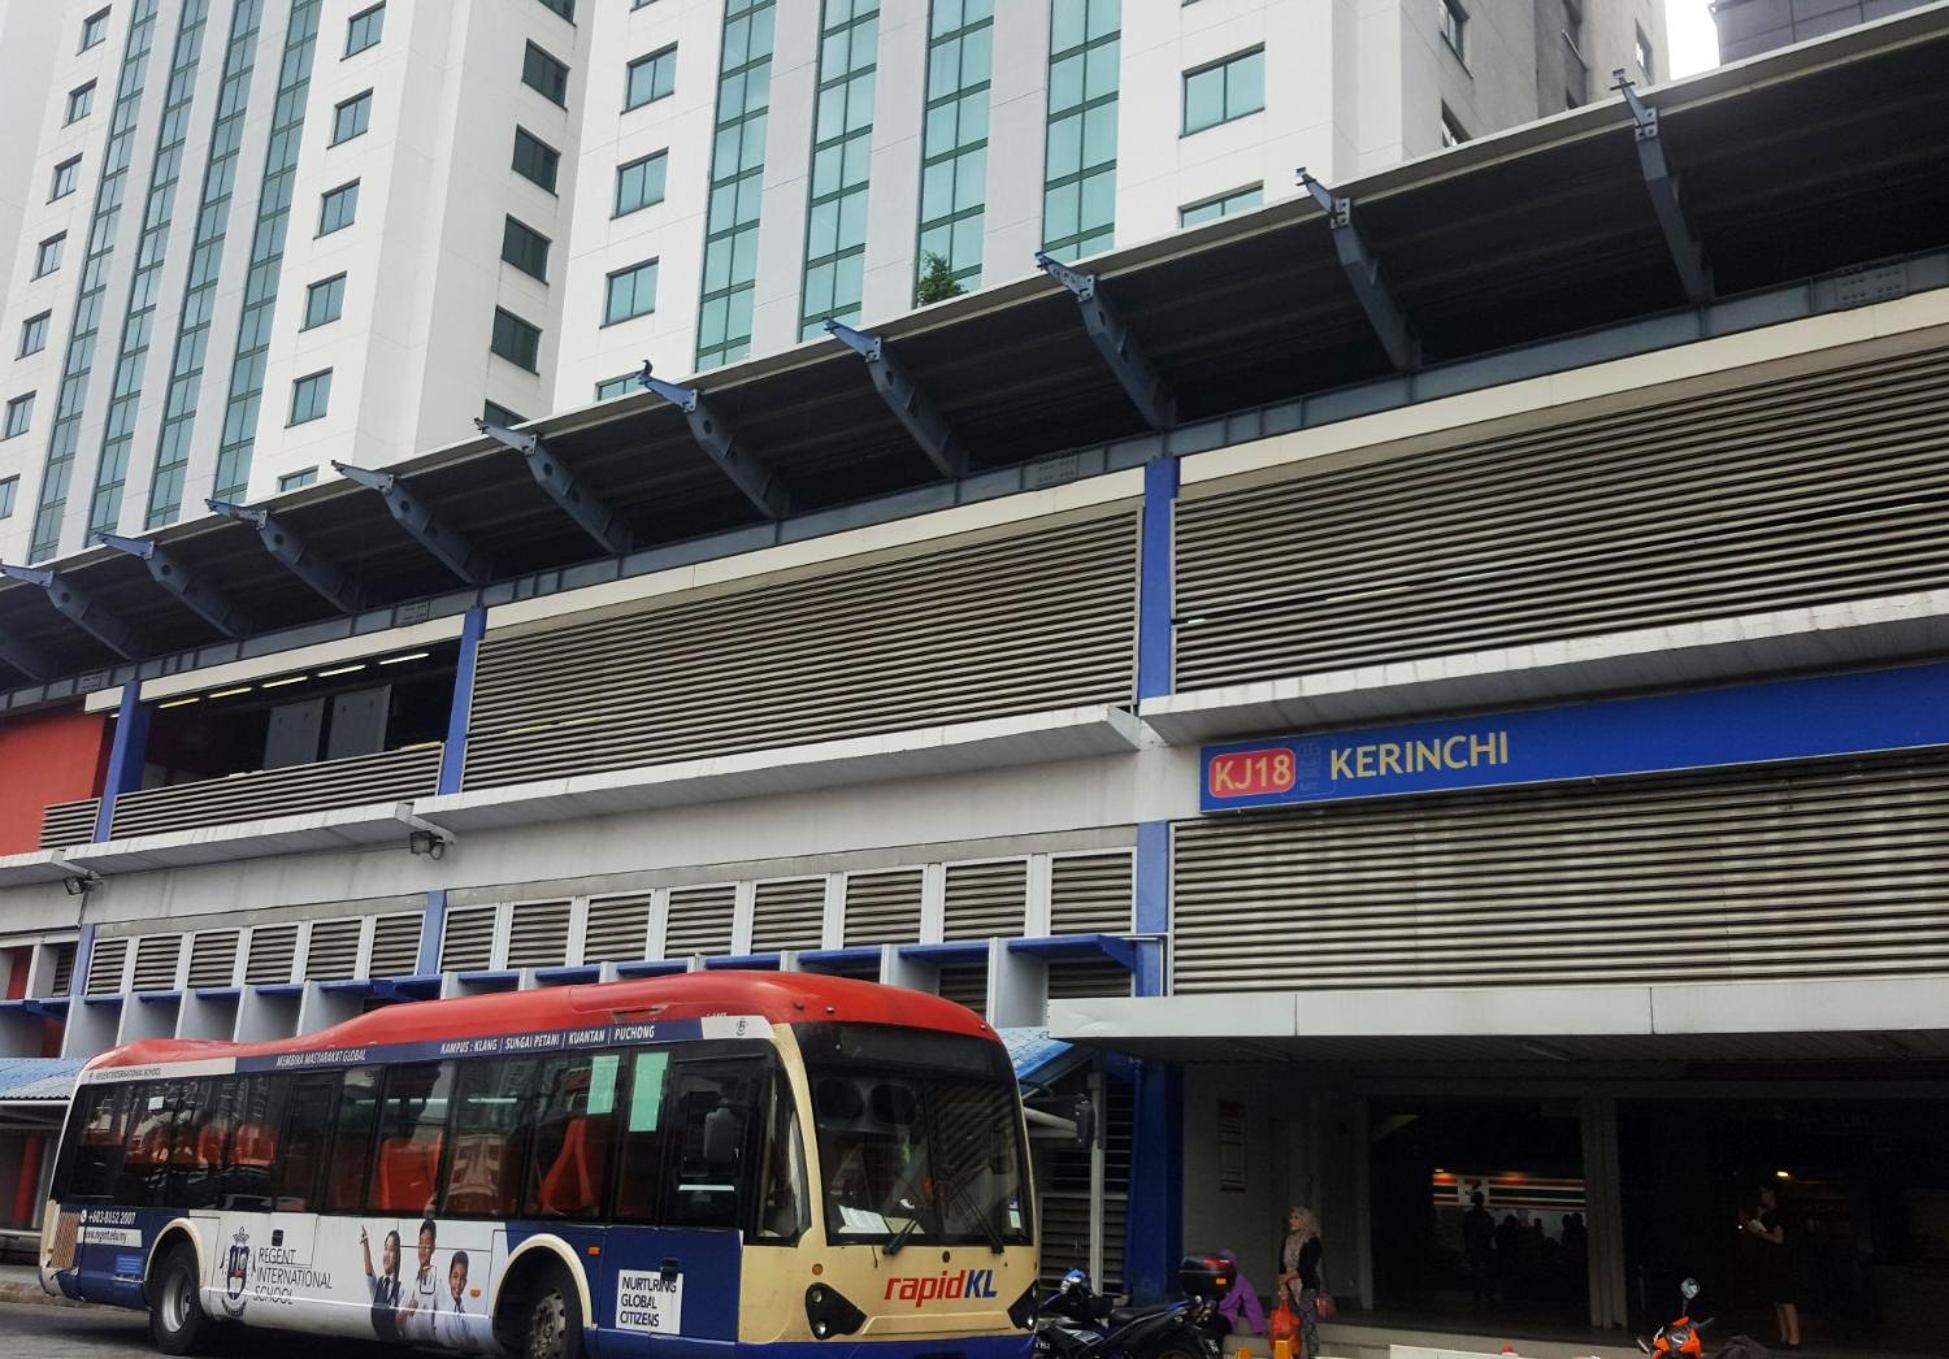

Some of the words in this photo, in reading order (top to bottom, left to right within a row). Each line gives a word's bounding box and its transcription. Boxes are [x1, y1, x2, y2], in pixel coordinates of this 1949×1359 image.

[1214, 755, 1291, 792] KJ18
[1331, 731, 1509, 780] KERINCHI
[440, 1041, 469, 1055] KAMPUS
[473, 1039, 497, 1052] KLANG
[504, 1035, 533, 1050] SUNGAI
[533, 1033, 560, 1048] PETANI
[568, 1029, 605, 1044] KUANTAN
[614, 1025, 655, 1040] PUCHONG
[342, 1048, 367, 1062] GLOBAL
[258, 1248, 296, 1265] REGENT
[256, 1267, 333, 1290] INTERNATIONAL
[884, 1269, 998, 1308] rapidKL
[253, 1285, 294, 1305] SCHOOL
[621, 1293, 657, 1309] GLOBAL
[620, 1310, 660, 1327] CITIZENS
